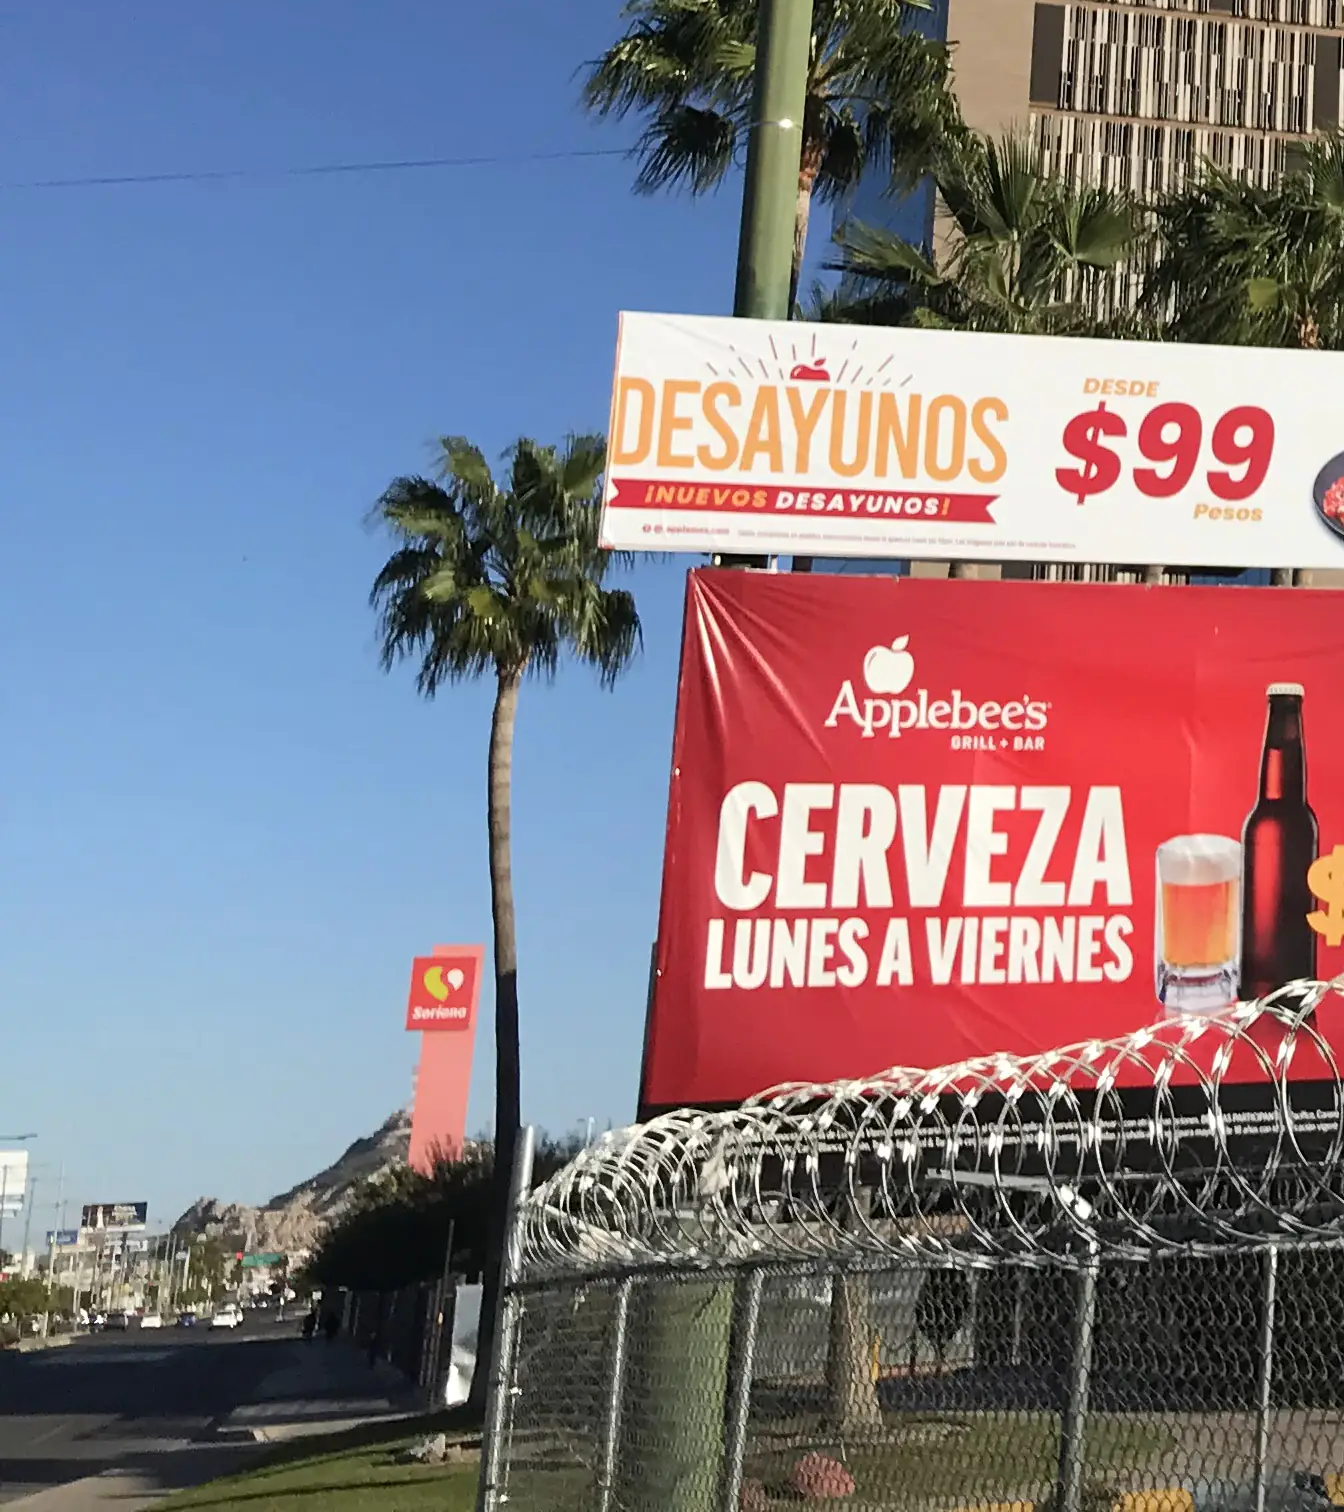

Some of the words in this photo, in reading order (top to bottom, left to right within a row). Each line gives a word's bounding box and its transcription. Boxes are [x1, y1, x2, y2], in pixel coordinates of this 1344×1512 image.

[1083, 377, 1161, 399] DESDE
[611, 376, 1010, 485] DESAYUNOS
[1054, 401, 1276, 506] $99
[774, 490, 952, 516] DESAYUNOS!
[1194, 502, 1264, 523] Pesos
[824, 679, 1048, 739] Applebee's
[951, 735, 997, 752] GRILL
[1013, 735, 1045, 752] BAR
[713, 780, 1134, 912] CERVEZA
[703, 916, 870, 991] LUNES
[876, 917, 914, 987] A
[925, 913, 1135, 987] VIERNES
[411, 1004, 467, 1021] Soriana
